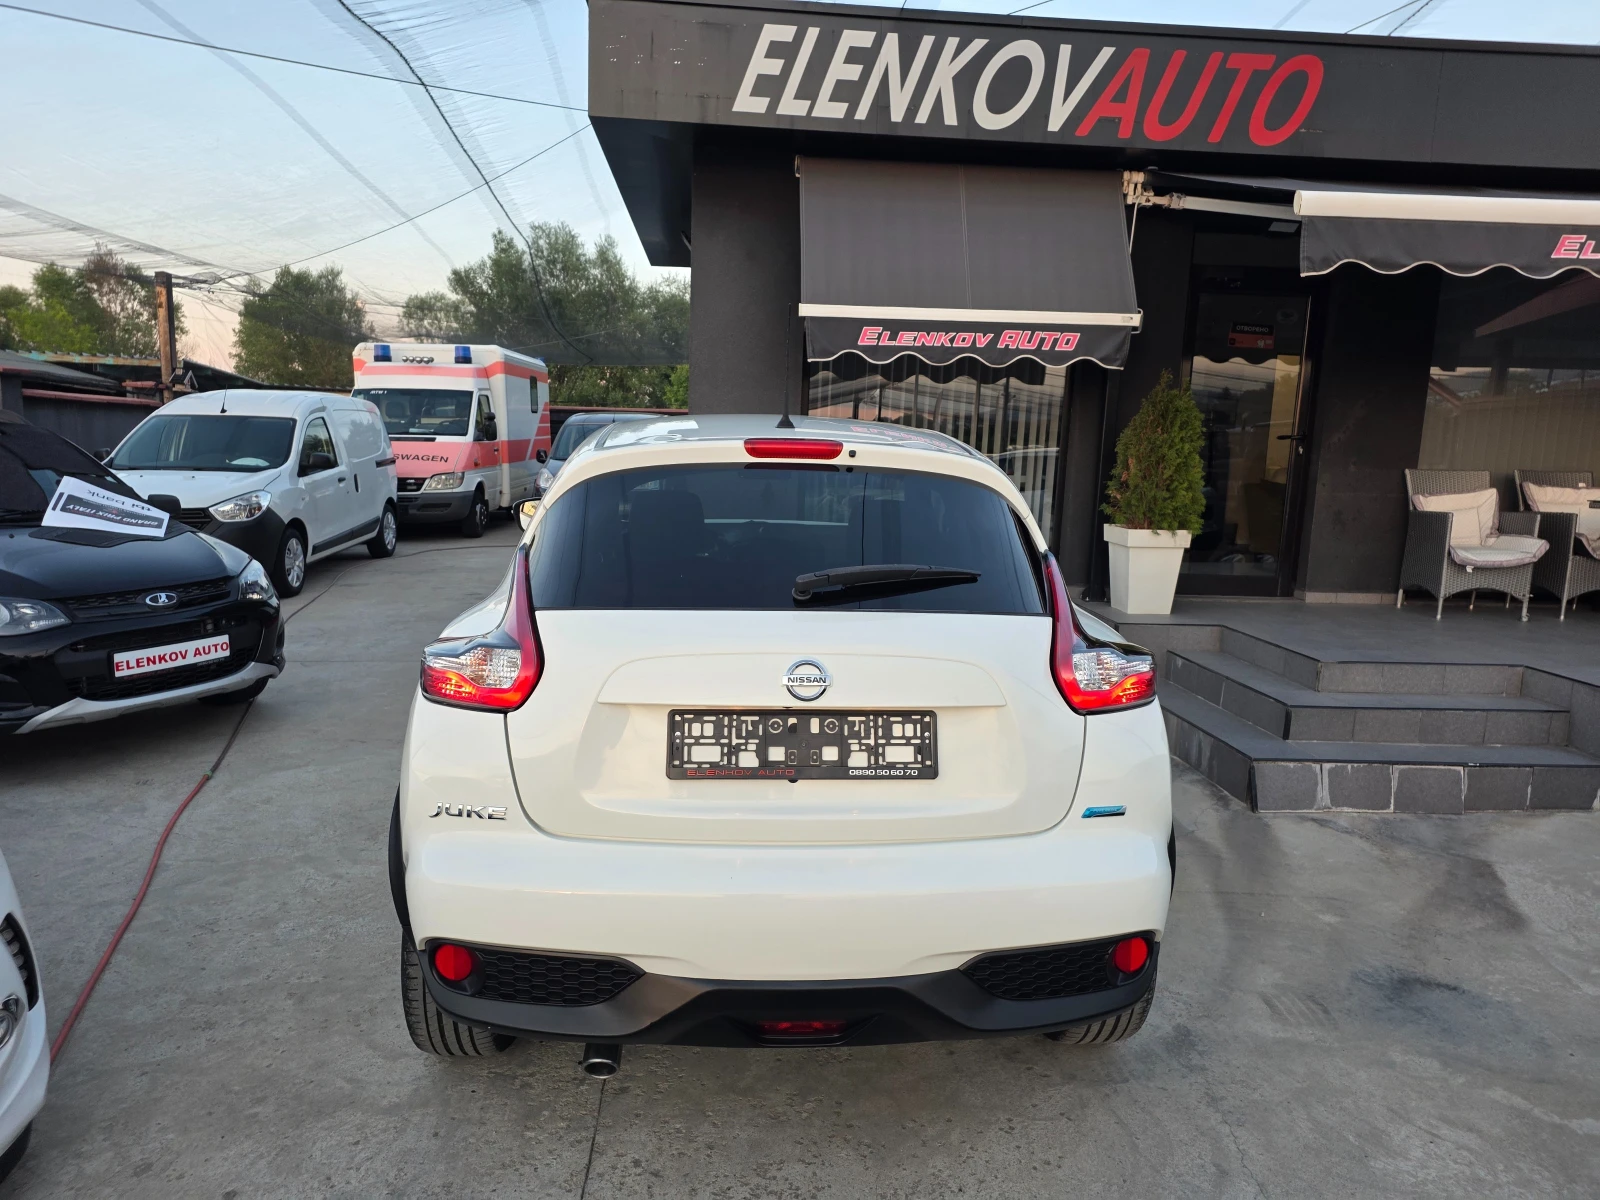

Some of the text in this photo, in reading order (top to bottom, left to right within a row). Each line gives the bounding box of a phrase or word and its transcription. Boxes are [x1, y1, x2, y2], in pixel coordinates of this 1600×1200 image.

[858, 326, 1080, 351] ELENKOV AUTO
[115, 649, 188, 672] ELENKOV
[193, 642, 229, 657] AUTO
[787, 676, 827, 684] NISSAN
[428, 802, 507, 820] JUKE
